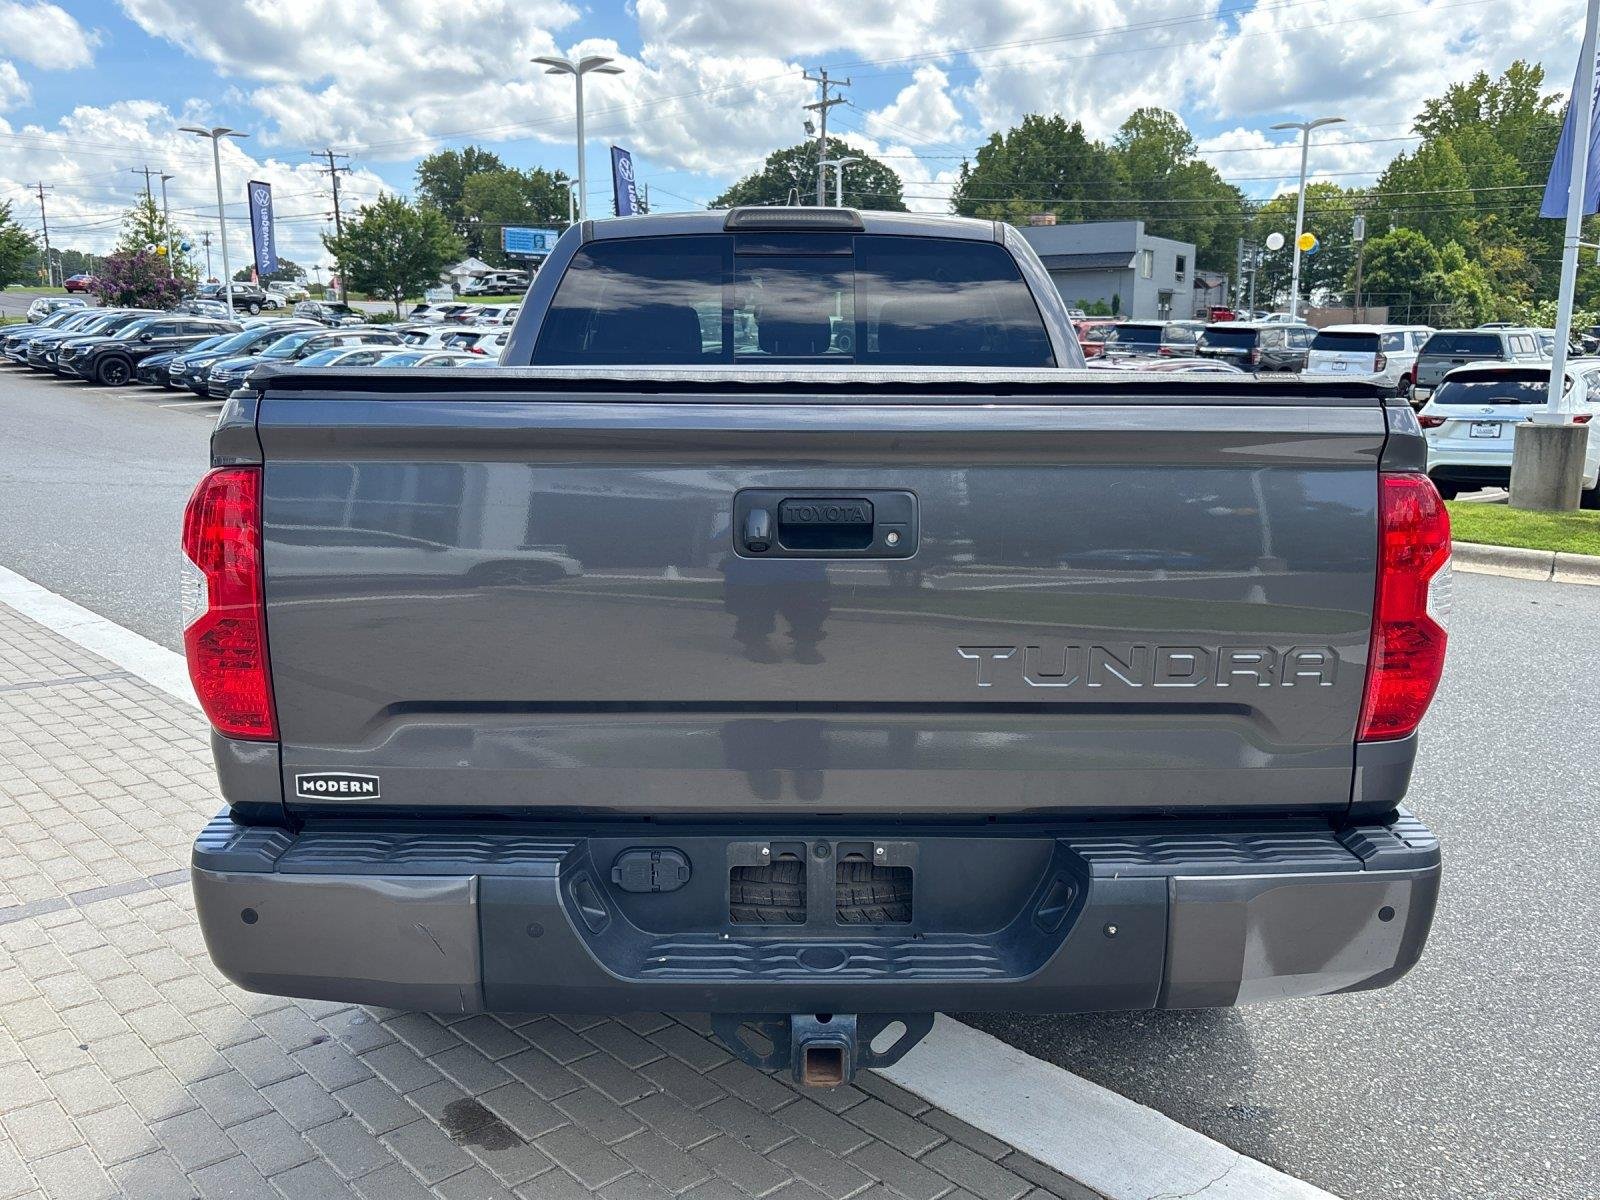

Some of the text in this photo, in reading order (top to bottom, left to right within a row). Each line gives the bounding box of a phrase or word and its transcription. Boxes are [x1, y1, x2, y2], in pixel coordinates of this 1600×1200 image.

[786, 505, 867, 522] TOYOTA
[957, 645, 1340, 688] TUNDRA
[302, 780, 374, 793] MODERN
